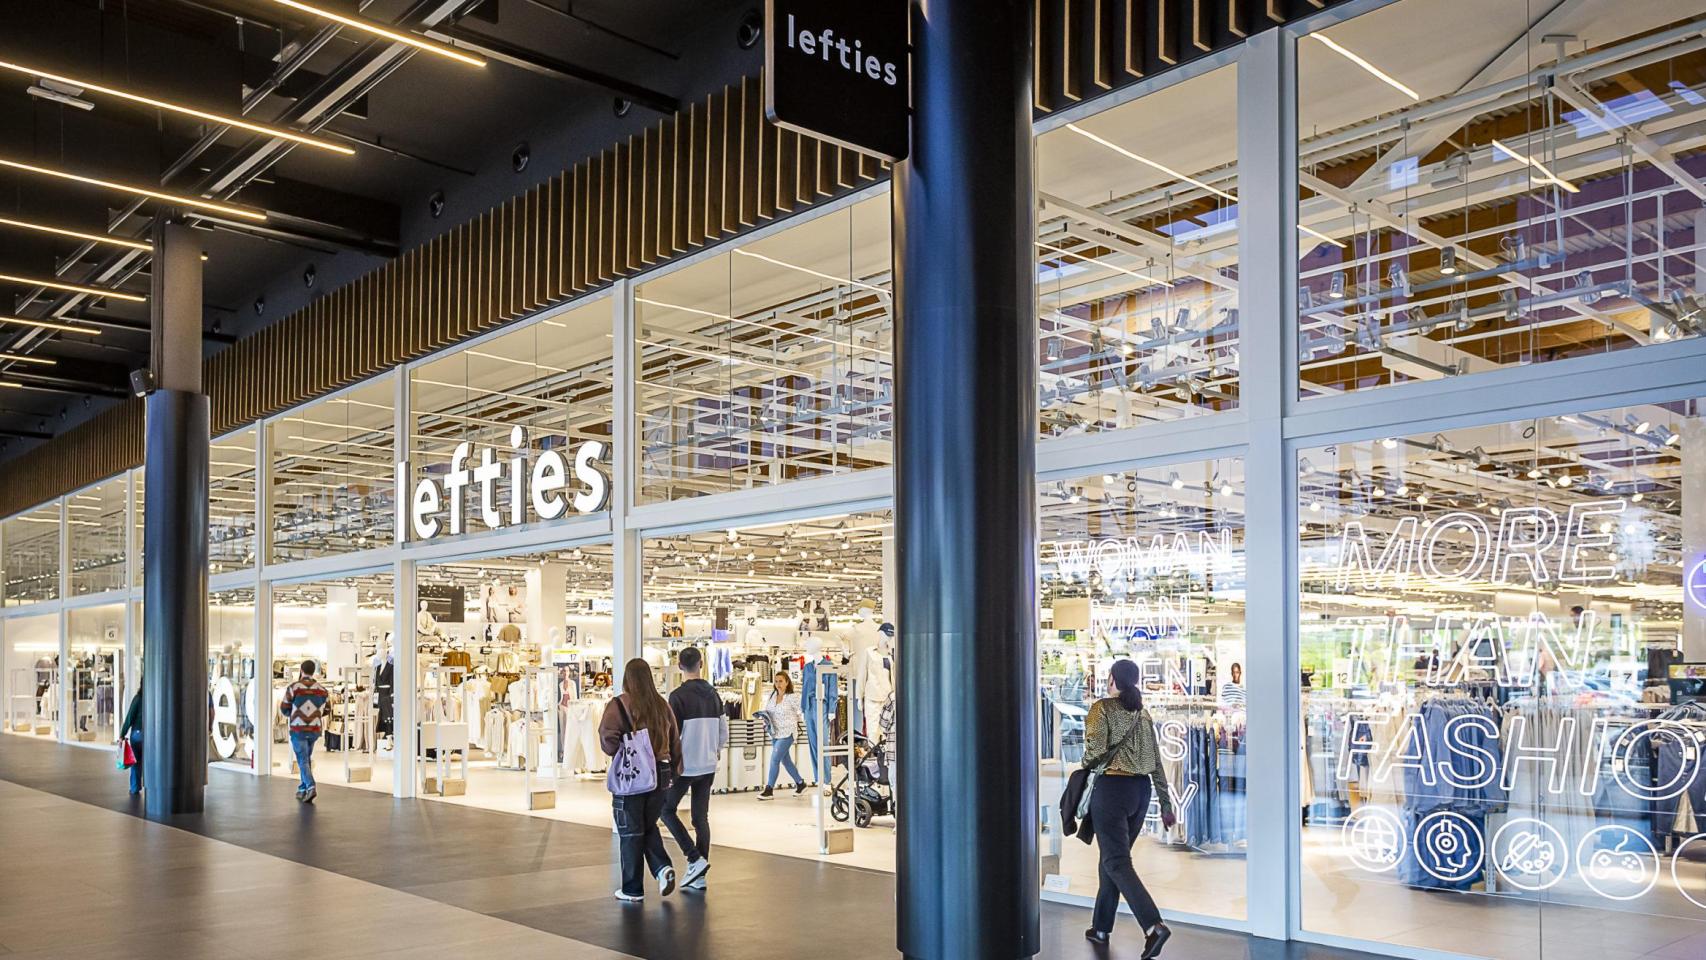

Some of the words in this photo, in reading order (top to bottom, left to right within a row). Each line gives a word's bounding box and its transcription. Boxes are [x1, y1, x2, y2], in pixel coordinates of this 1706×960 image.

[788, 13, 897, 86] lefties
[397, 424, 610, 543] lefties
[1055, 527, 1232, 578] WOMAN
[1335, 500, 1627, 592] MORE
[108, 630, 115, 639] 6
[747, 617, 755, 626] 12
[1090, 593, 1190, 637] MAN
[1334, 609, 1597, 688] THAN
[791, 671, 799, 679] 15
[1086, 657, 1194, 698] TEN
[1336, 672, 1348, 683] 12
[1623, 672, 1632, 683] 7
[1336, 711, 1706, 801] FASHIO
